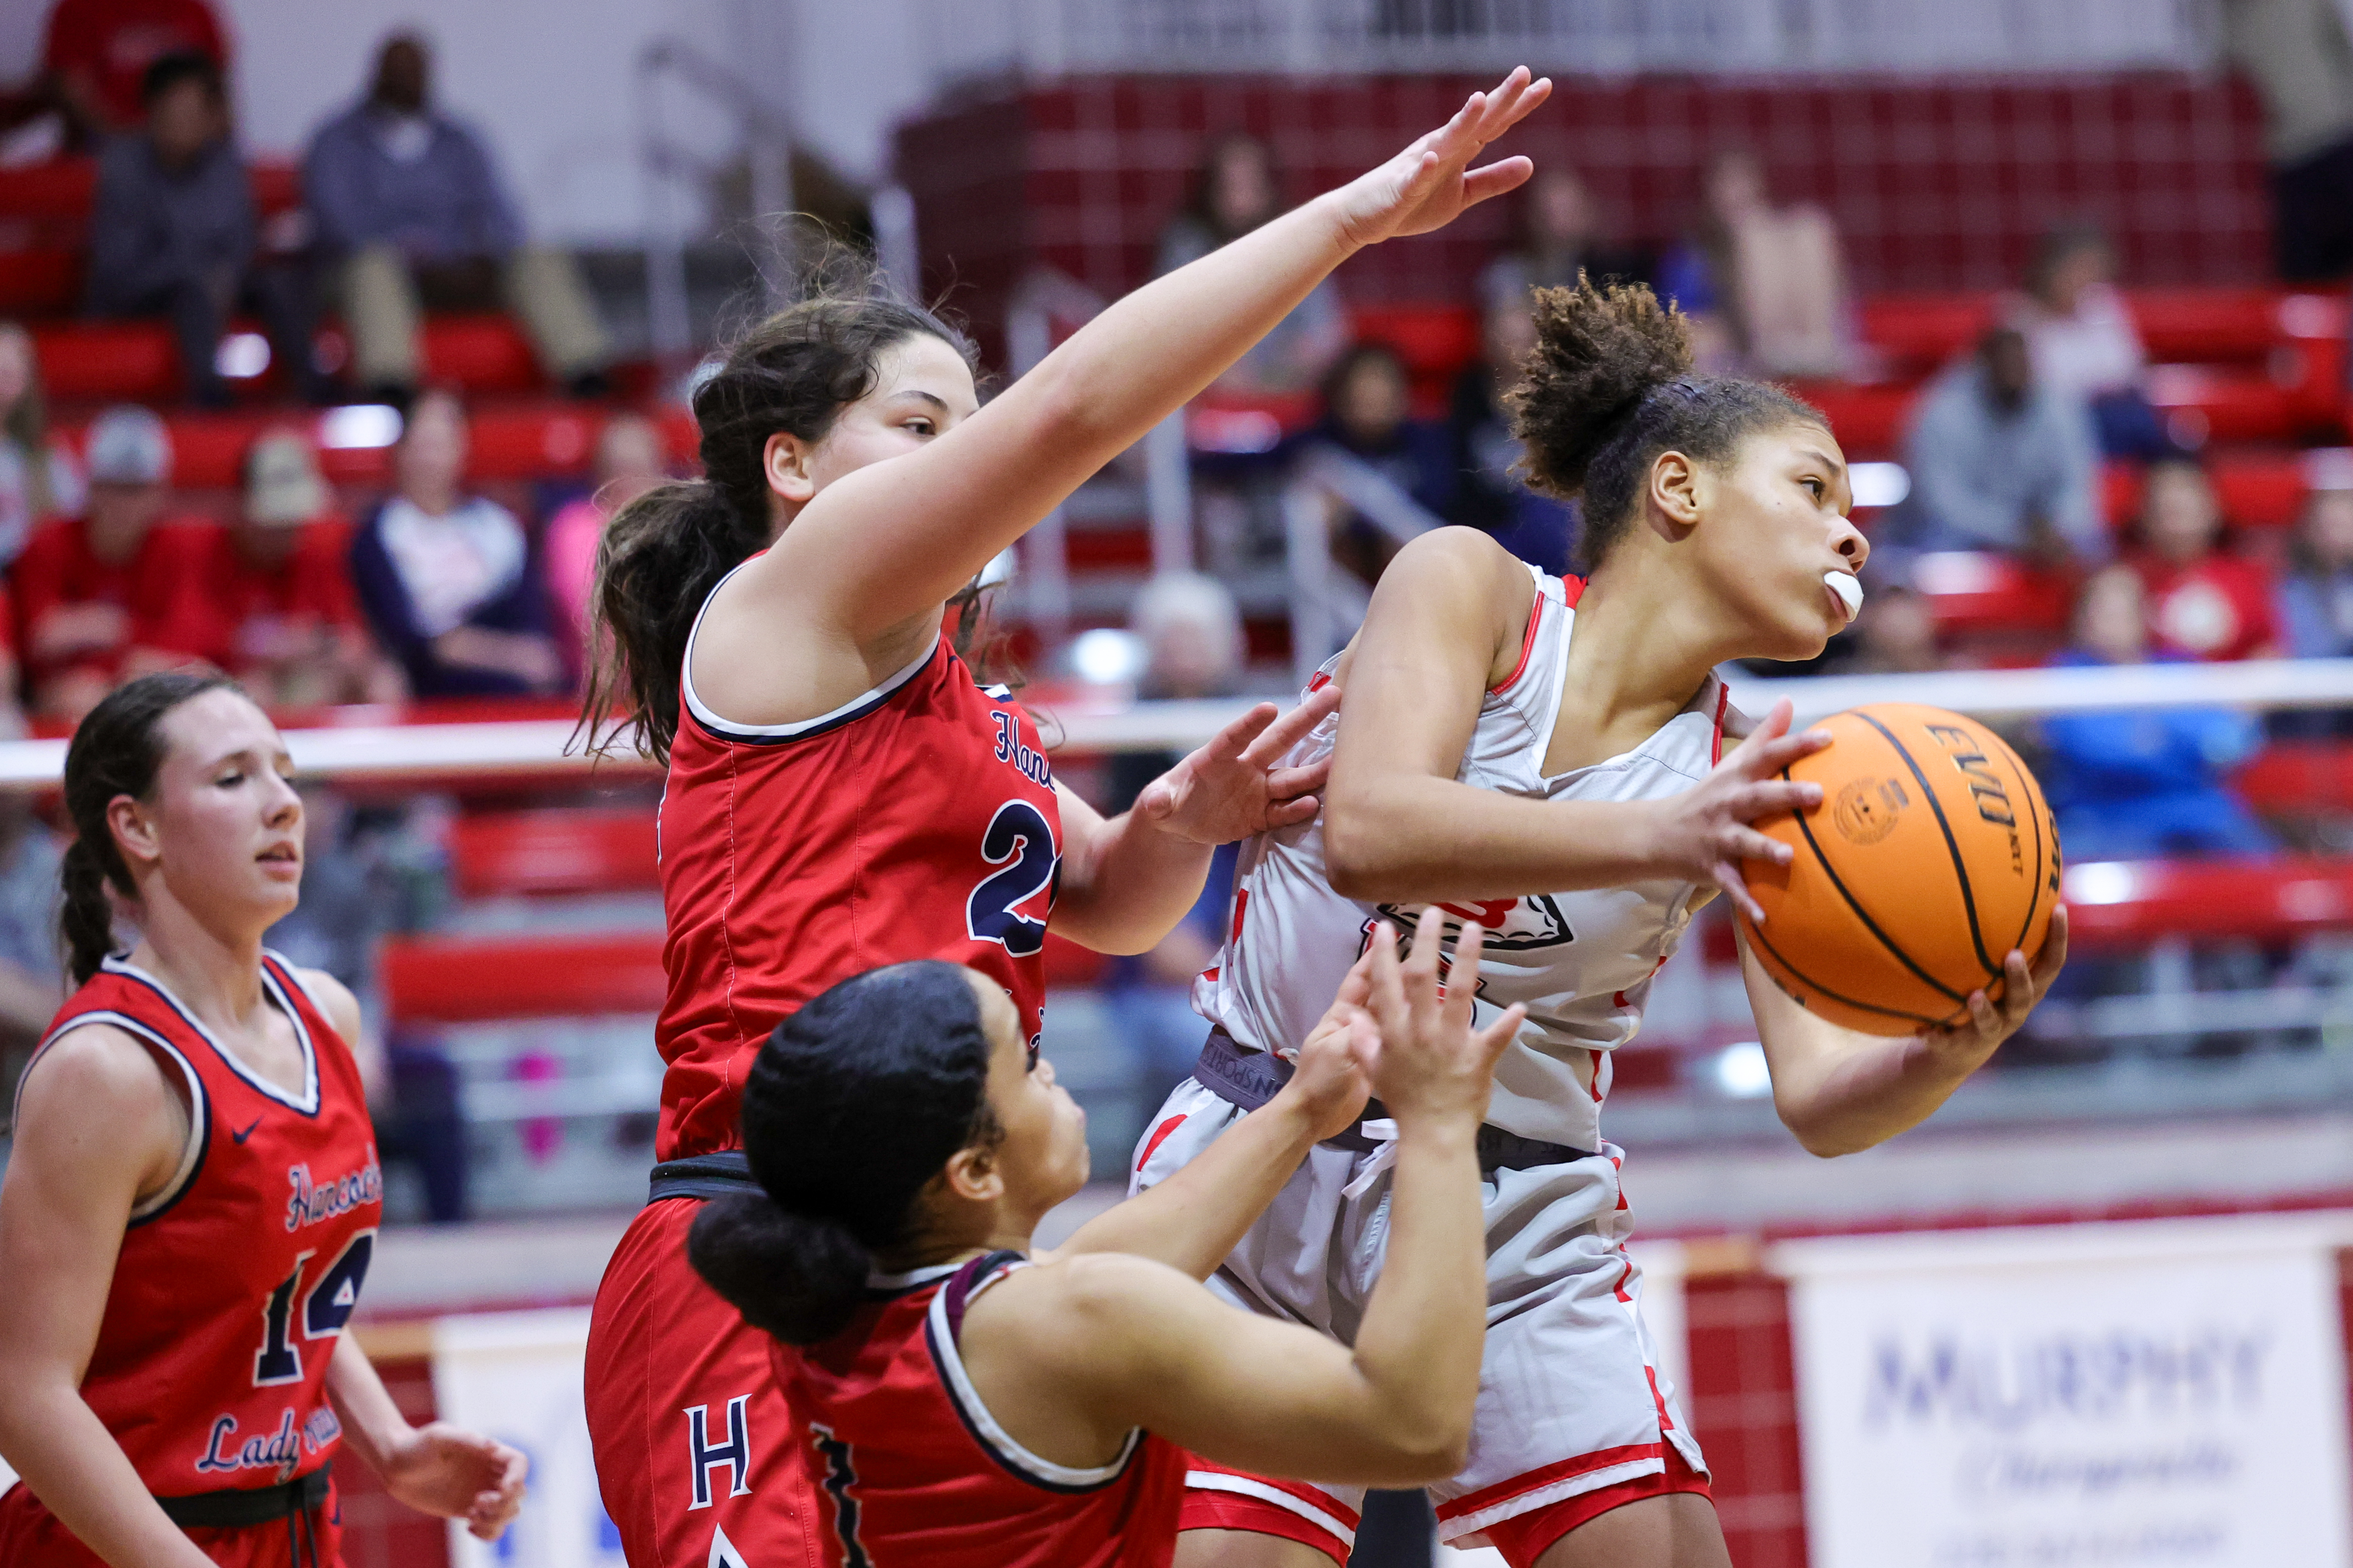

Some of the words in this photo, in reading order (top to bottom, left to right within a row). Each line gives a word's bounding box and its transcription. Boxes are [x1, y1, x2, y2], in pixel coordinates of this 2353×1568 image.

[990, 709, 1056, 795] Han
[1923, 725, 2016, 828] EVO
[966, 798, 1063, 957] 2
[253, 1225, 378, 1387] 14
[196, 1407, 300, 1486] Lady
